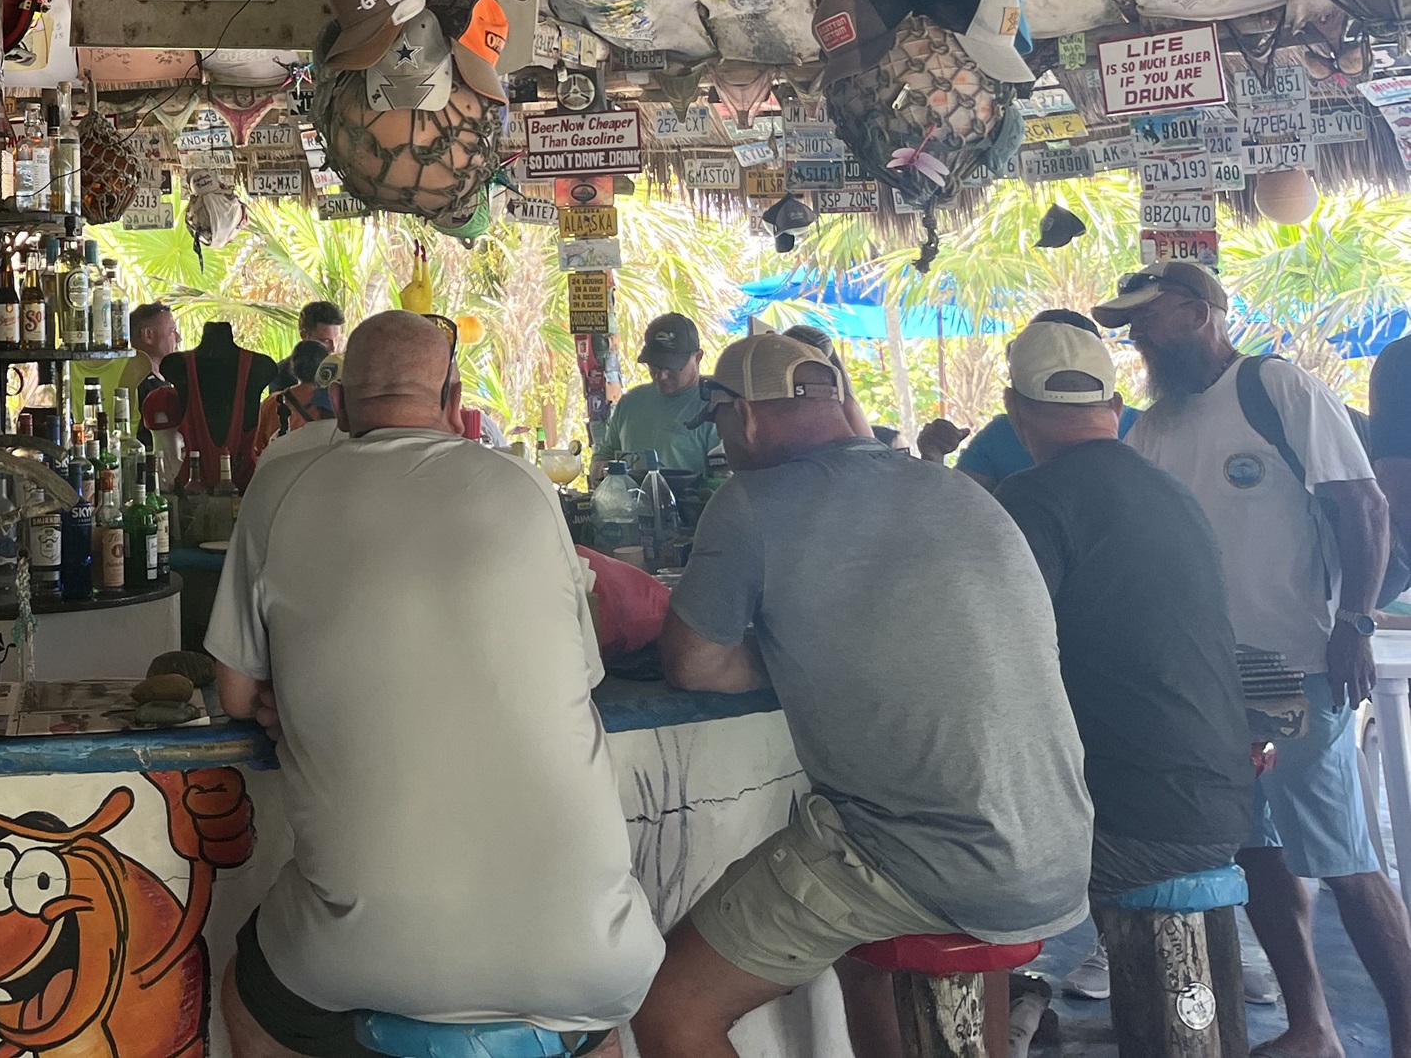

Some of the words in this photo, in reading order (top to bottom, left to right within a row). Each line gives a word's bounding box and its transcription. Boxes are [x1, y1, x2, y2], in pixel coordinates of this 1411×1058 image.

[1127, 36, 1184, 59] LIFE
[1106, 63, 1118, 76] IS
[1121, 61, 1135, 73] SO
[1139, 56, 1166, 71] MUCH
[1170, 50, 1211, 67] EASIER
[1120, 76, 1135, 88] IF
[1143, 70, 1168, 85] YOU
[1175, 66, 1202, 81] ARE
[1124, 82, 1195, 106] DRUNK
[560, 118, 584, 133] Now
[588, 117, 634, 132] Cheaper
[657, 117, 679, 135] 252
[685, 116, 708, 133] CXT
[1243, 112, 1307, 135] 4ZPE541
[540, 135, 568, 148] Than
[571, 132, 625, 147] Gasoline
[797, 138, 834, 154] SHOTS
[529, 155, 543, 170] SO
[544, 152, 574, 169] DON'T
[575, 151, 605, 168] DRIVE
[609, 149, 641, 166] DRINK
[1247, 146, 1273, 165] WJX
[1143, 163, 1170, 183] GZW
[1172, 159, 1208, 181] 3193
[1215, 164, 1240, 181] 480
[819, 192, 841, 209] SSP
[848, 191, 877, 207] ZONE
[564, 214, 614, 233] ALASKA
[1143, 204, 1212, 224] 8B20470
